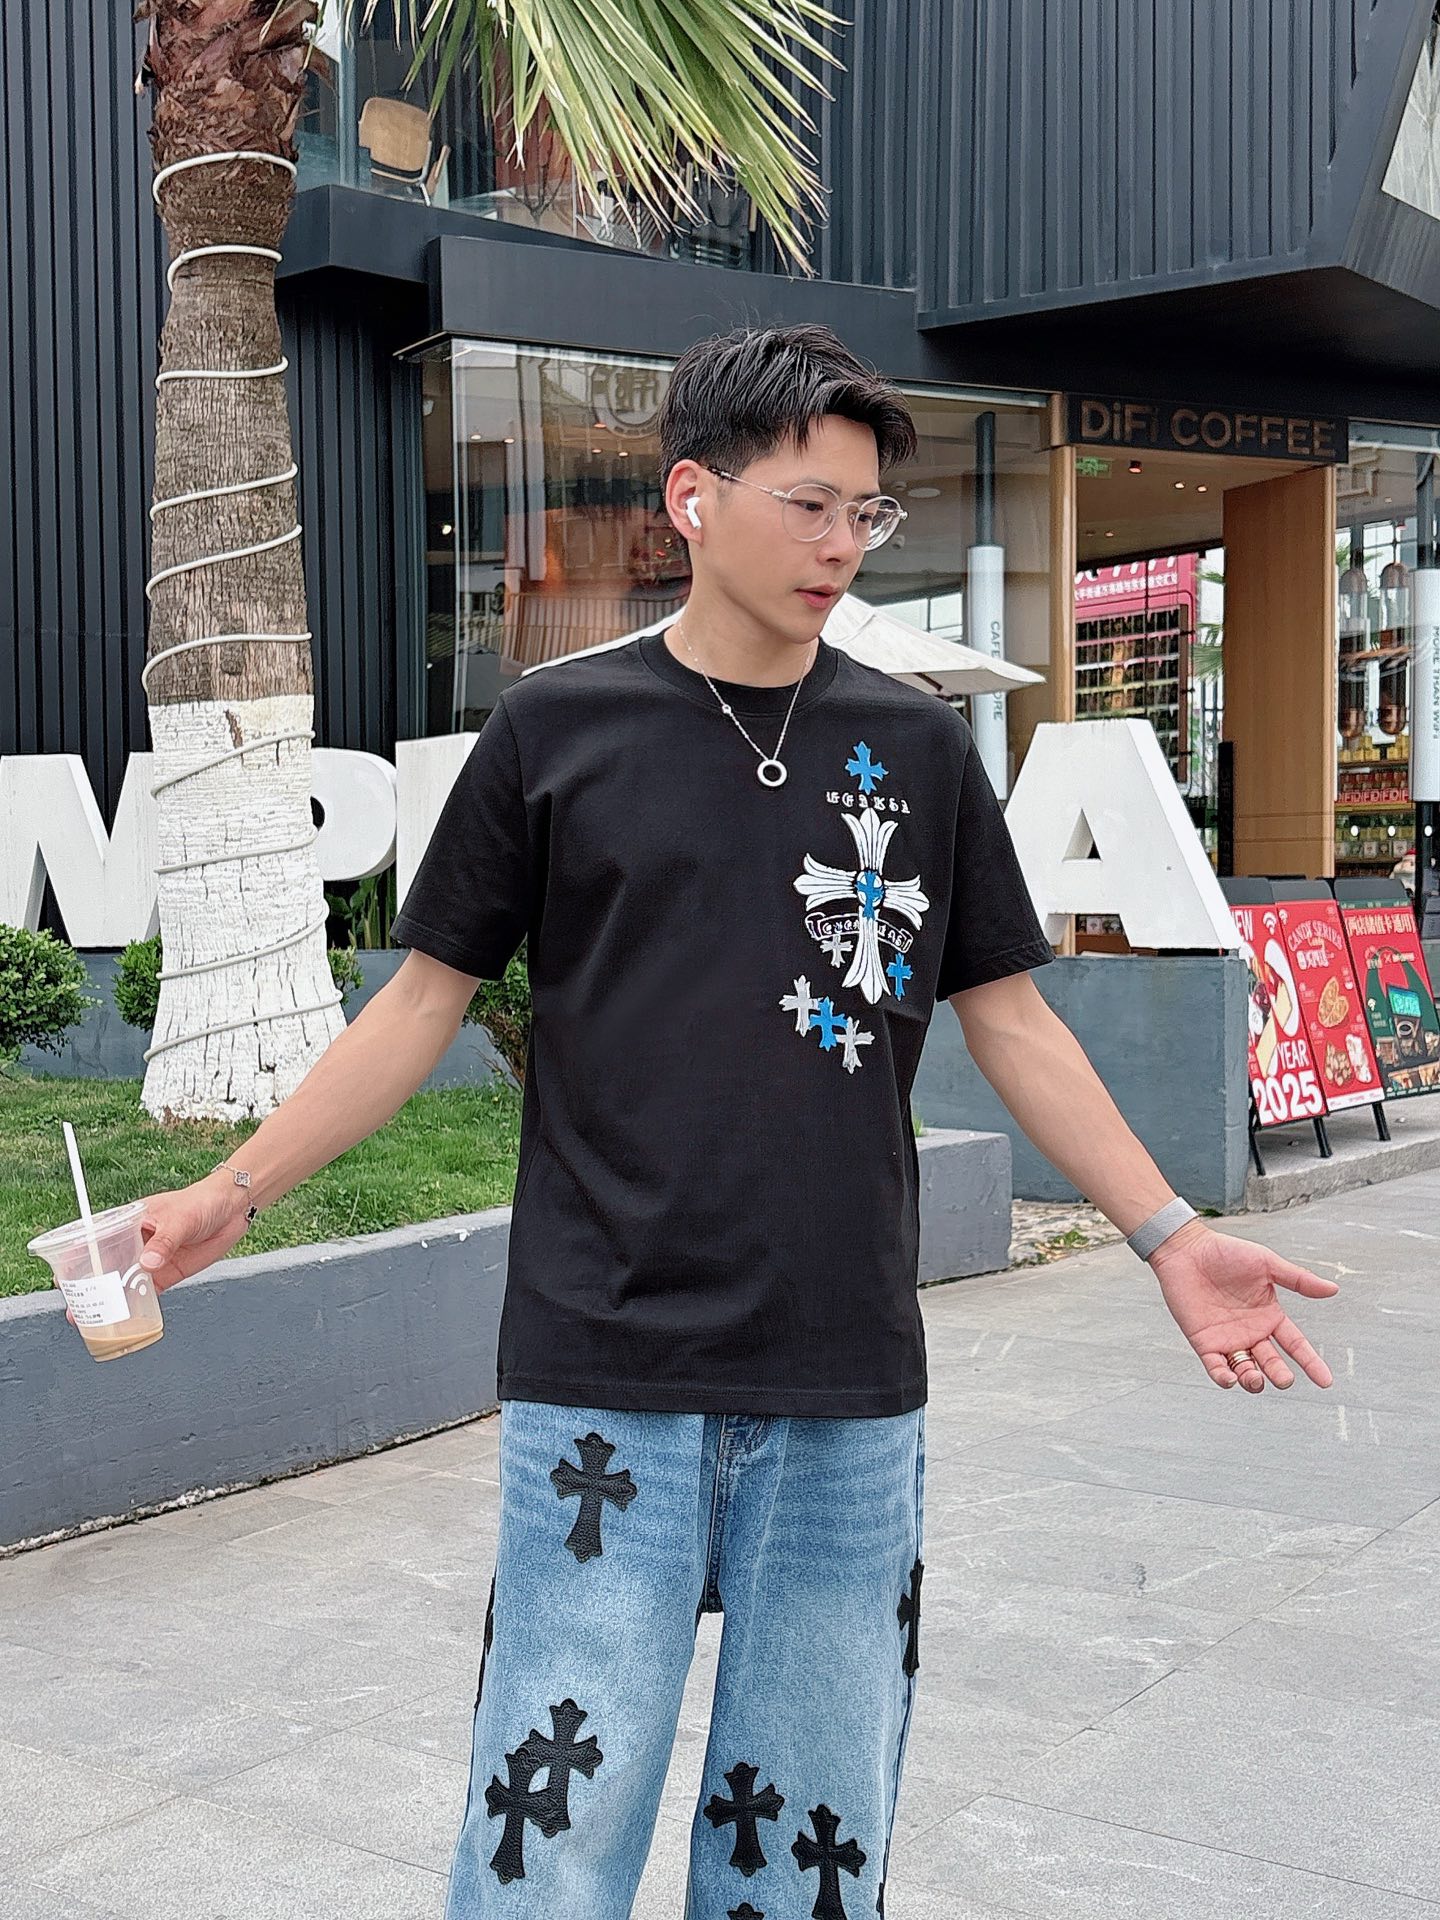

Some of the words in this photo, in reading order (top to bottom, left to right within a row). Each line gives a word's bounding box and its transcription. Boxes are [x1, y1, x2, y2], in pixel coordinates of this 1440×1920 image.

[1170, 407, 1336, 458] COFFEE
[990, 620, 1001, 659] CAFE
[992, 690, 1003, 720] ORE
[1231, 909, 1254, 942] EW
[1276, 1039, 1310, 1071] YEAR
[1252, 1069, 1323, 1125] 2025
